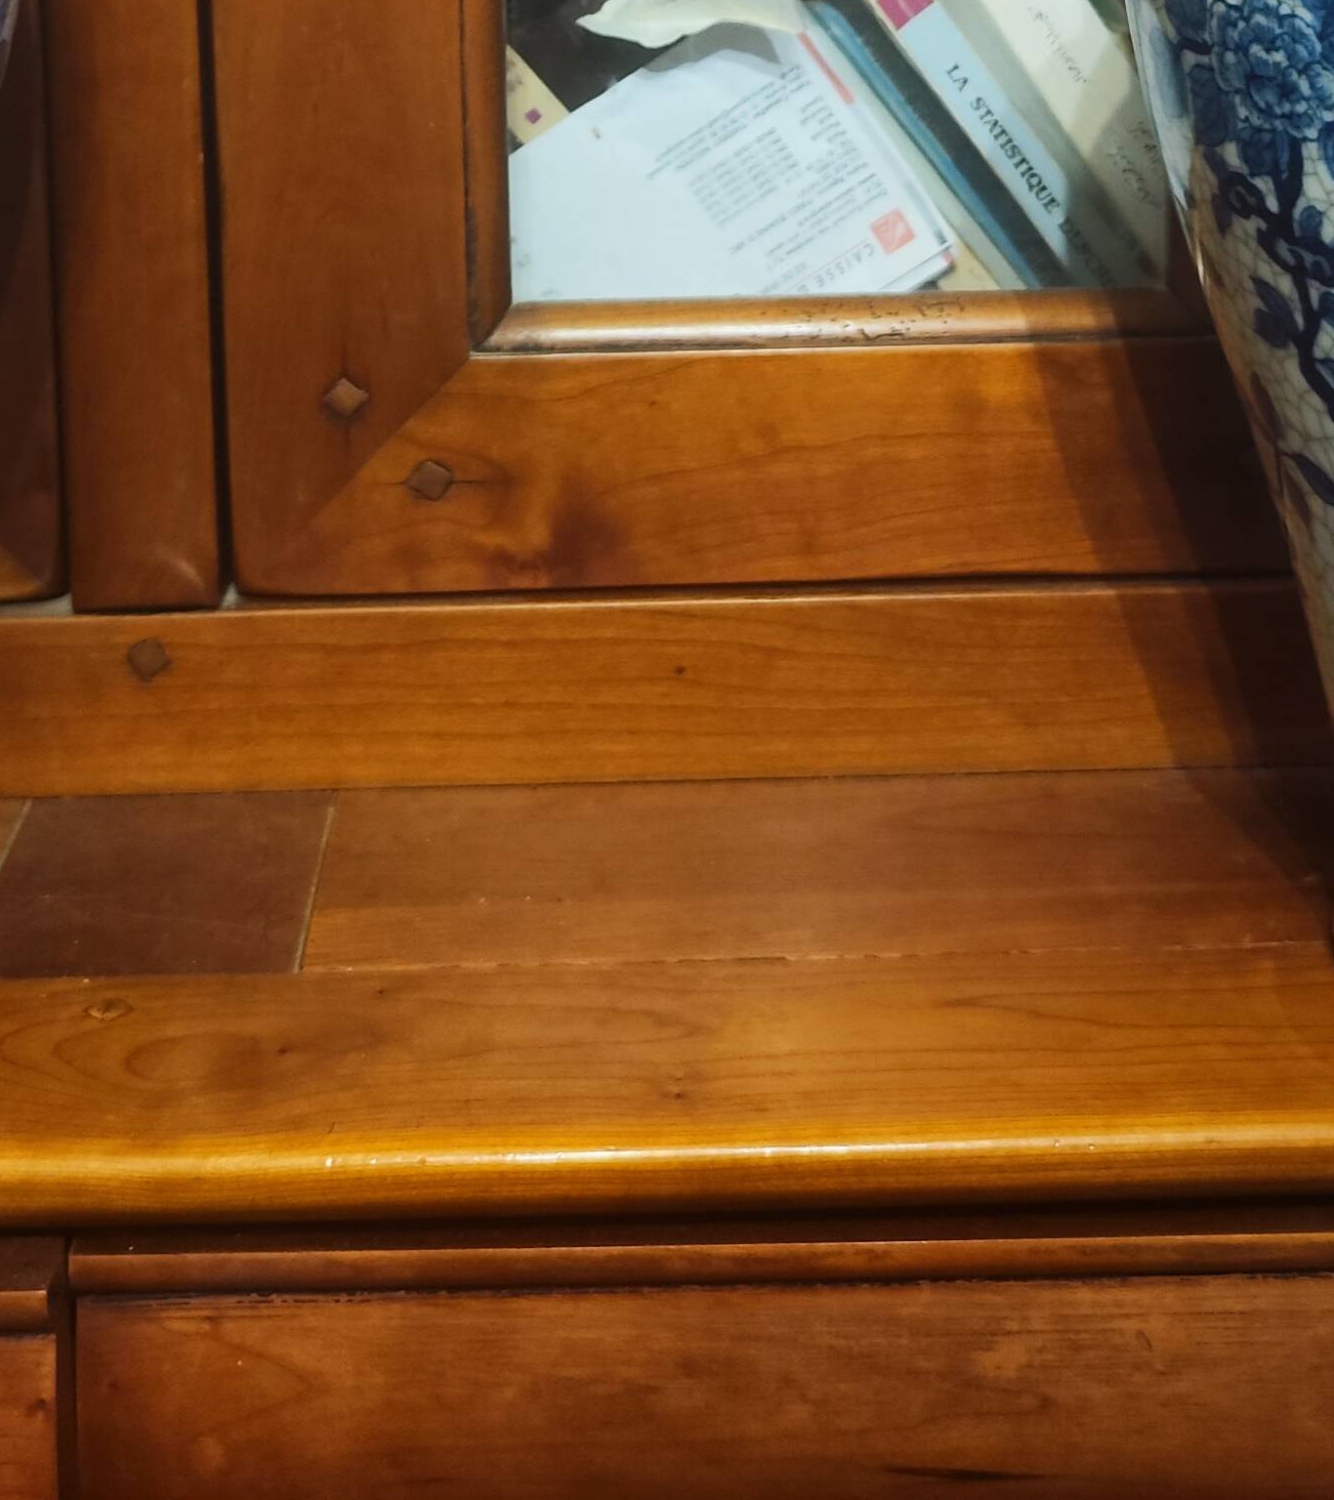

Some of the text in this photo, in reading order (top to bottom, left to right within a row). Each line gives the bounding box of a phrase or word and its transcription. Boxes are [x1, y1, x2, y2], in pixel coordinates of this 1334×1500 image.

[945, 63, 969, 93] LA
[969, 96, 1061, 216] STATISTIQUE
[815, 242, 876, 288] CAISSE
